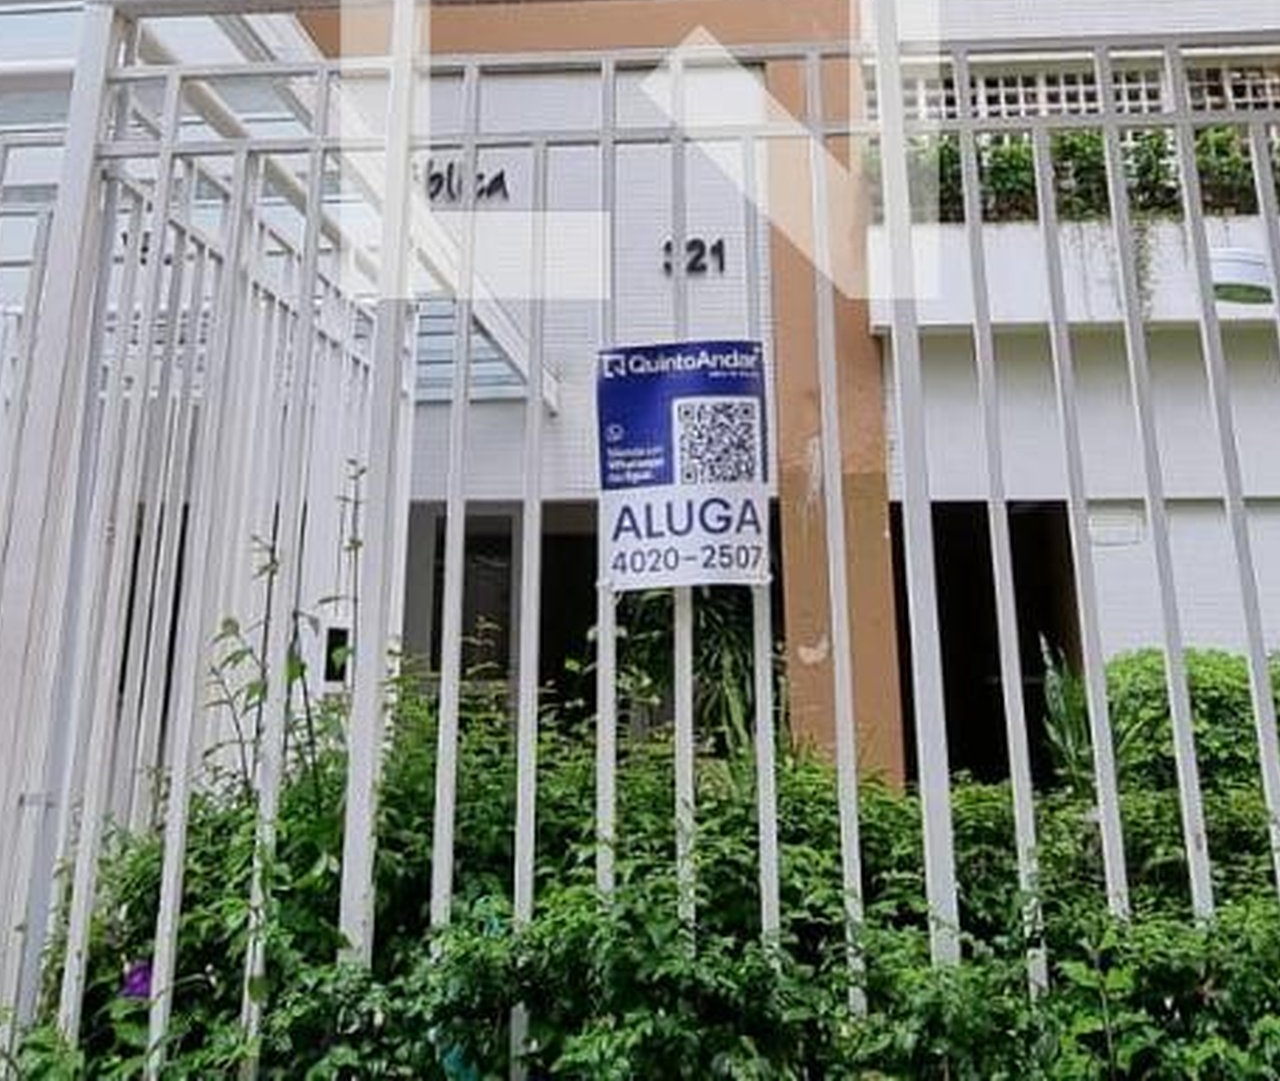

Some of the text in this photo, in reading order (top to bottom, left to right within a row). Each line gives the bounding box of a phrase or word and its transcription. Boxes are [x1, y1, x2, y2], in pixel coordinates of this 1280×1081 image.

[629, 350, 757, 374] QuintoAndar
[612, 498, 761, 542] ALUGA
[612, 545, 762, 574] 4020-2507
